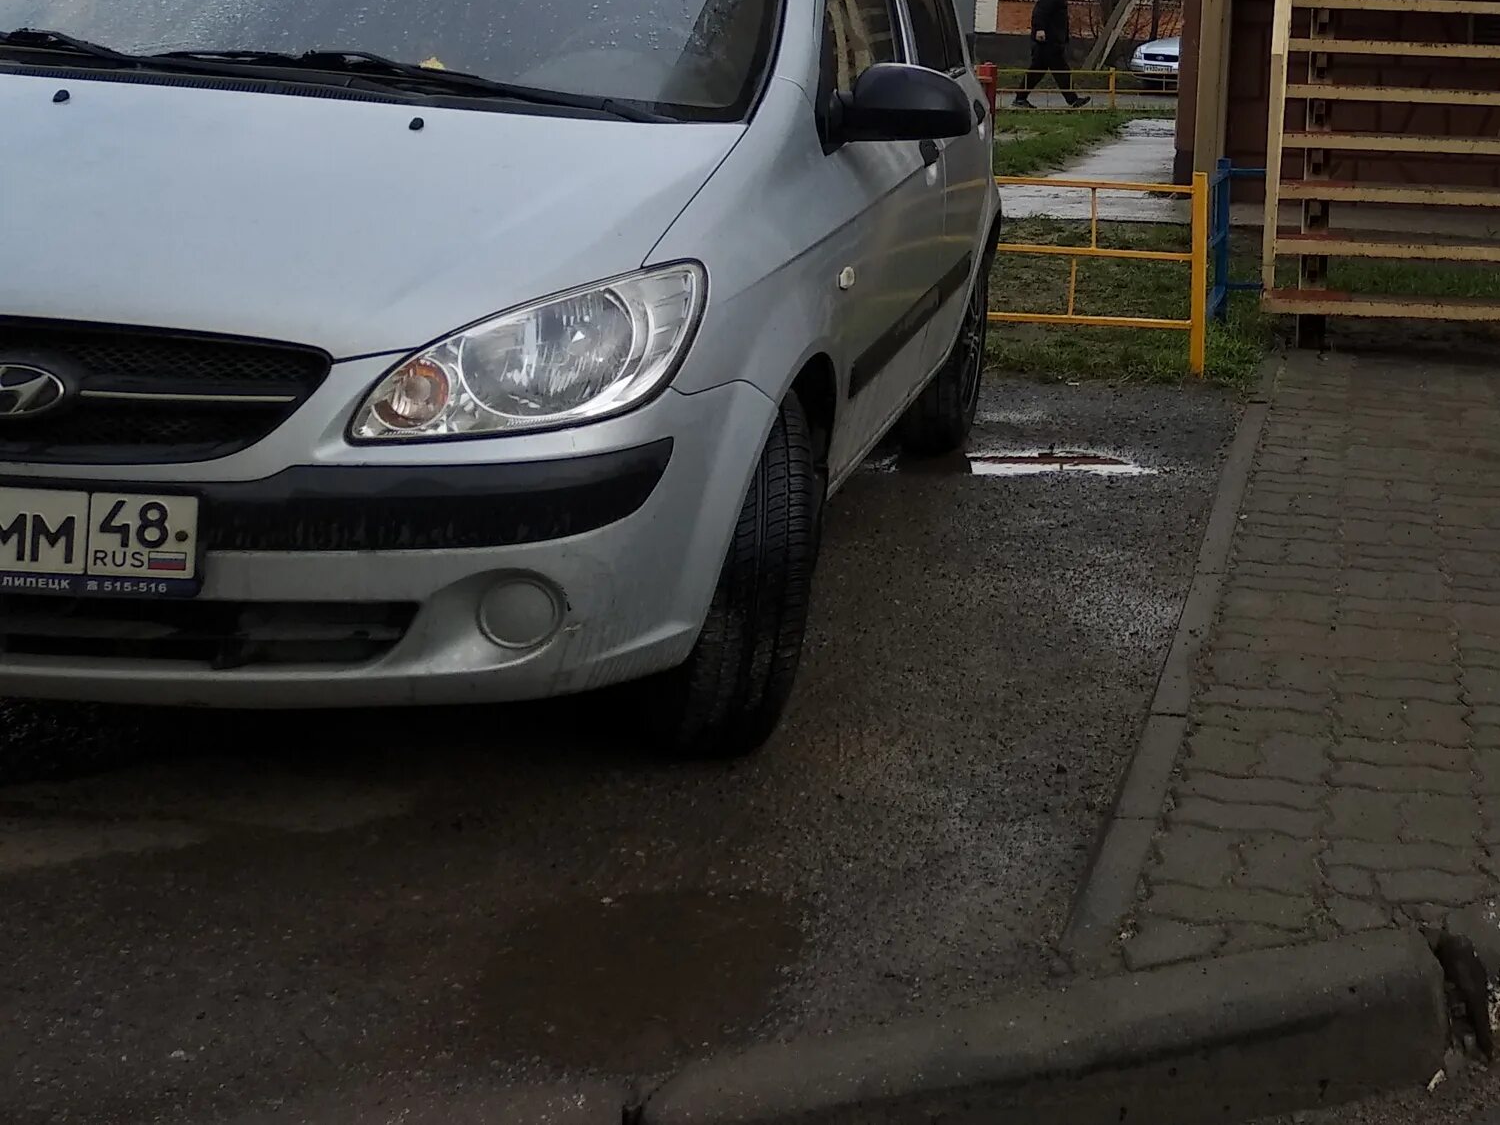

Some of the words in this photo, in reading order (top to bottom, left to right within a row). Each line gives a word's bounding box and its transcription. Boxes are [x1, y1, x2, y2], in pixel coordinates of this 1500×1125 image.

[99, 499, 169, 549] 48
[93, 549, 145, 568] RUS
[1, 576, 71, 591] ЛИПЕЦК
[103, 580, 168, 594] 515-516
